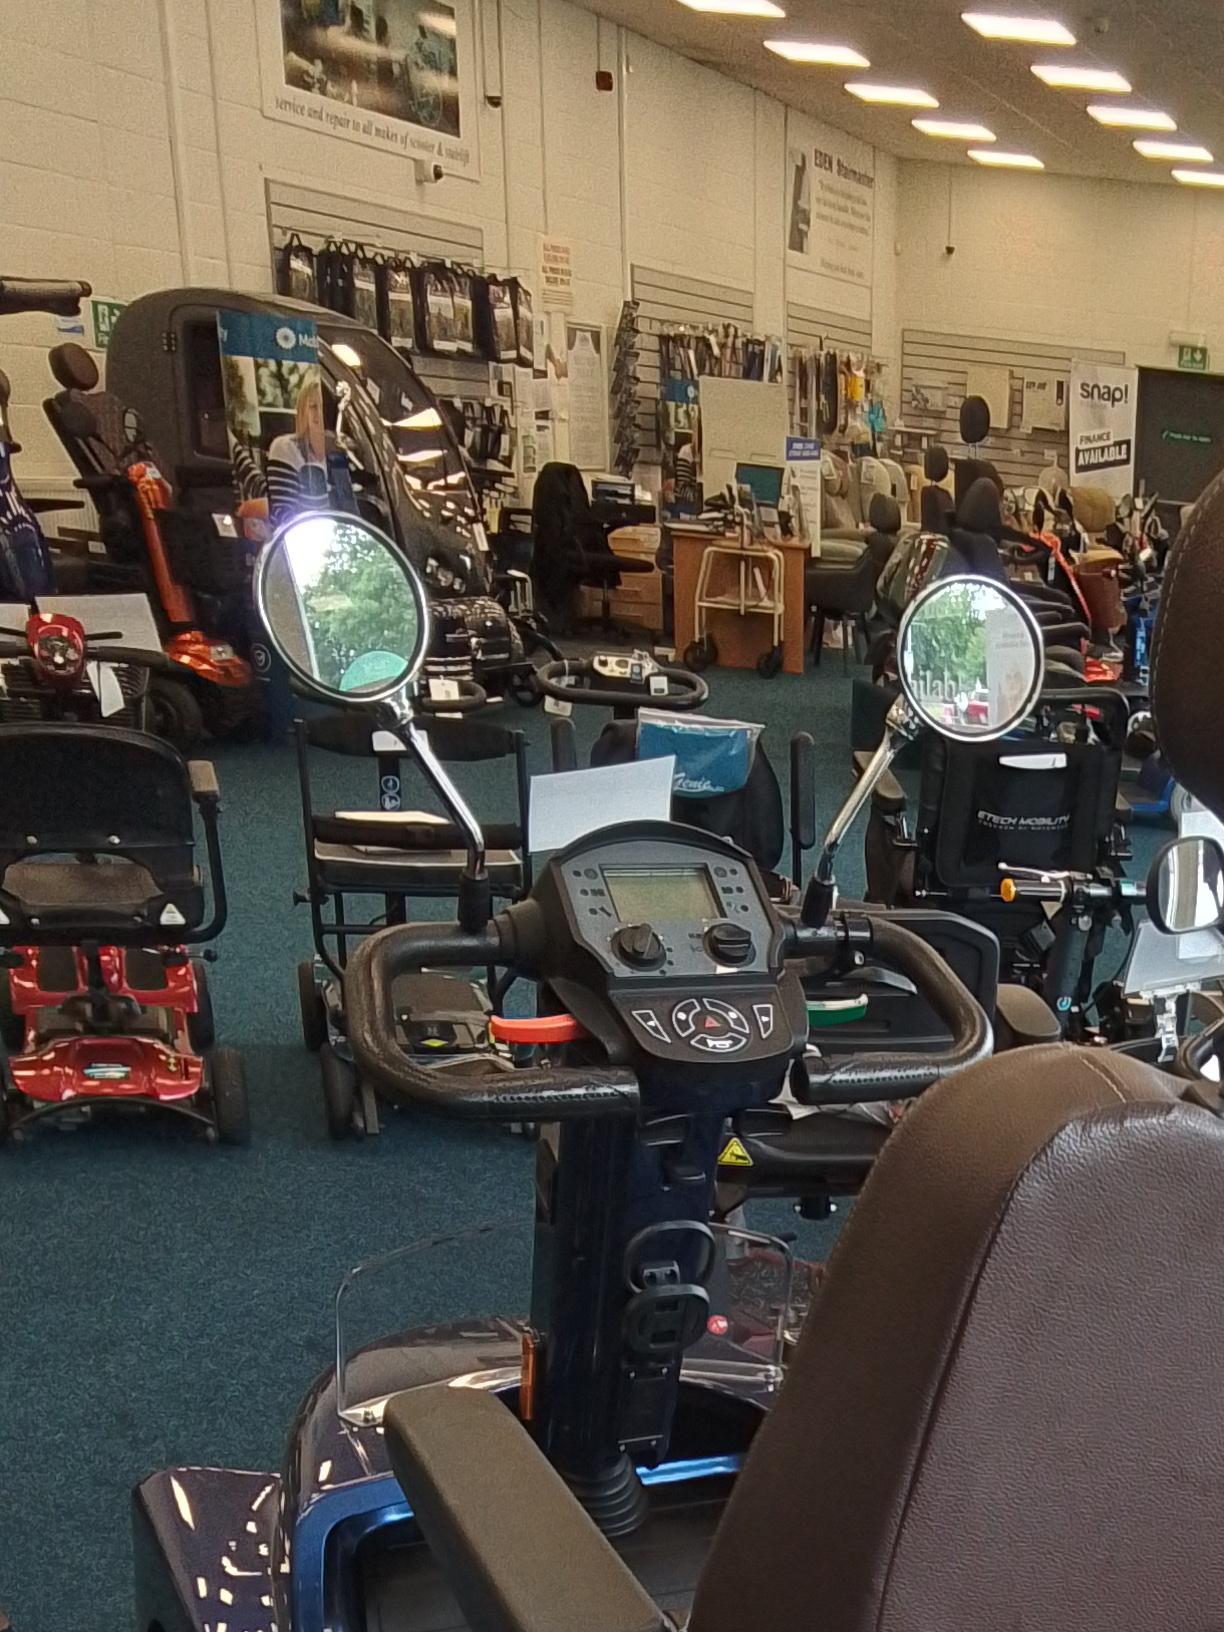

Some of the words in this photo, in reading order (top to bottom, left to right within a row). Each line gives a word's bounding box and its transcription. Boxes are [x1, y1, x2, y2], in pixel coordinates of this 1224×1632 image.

[275, 97, 305, 116] service
[307, 107, 323, 121] and
[326, 112, 351, 130] repair
[362, 120, 373, 136] all
[1079, 382, 1129, 408] snap!
[1079, 431, 1112, 446] FINANCE
[1077, 443, 1129, 467] AVAILABLE
[977, 810, 1018, 825] ETECH
[1018, 813, 1070, 826] MOBILITY
